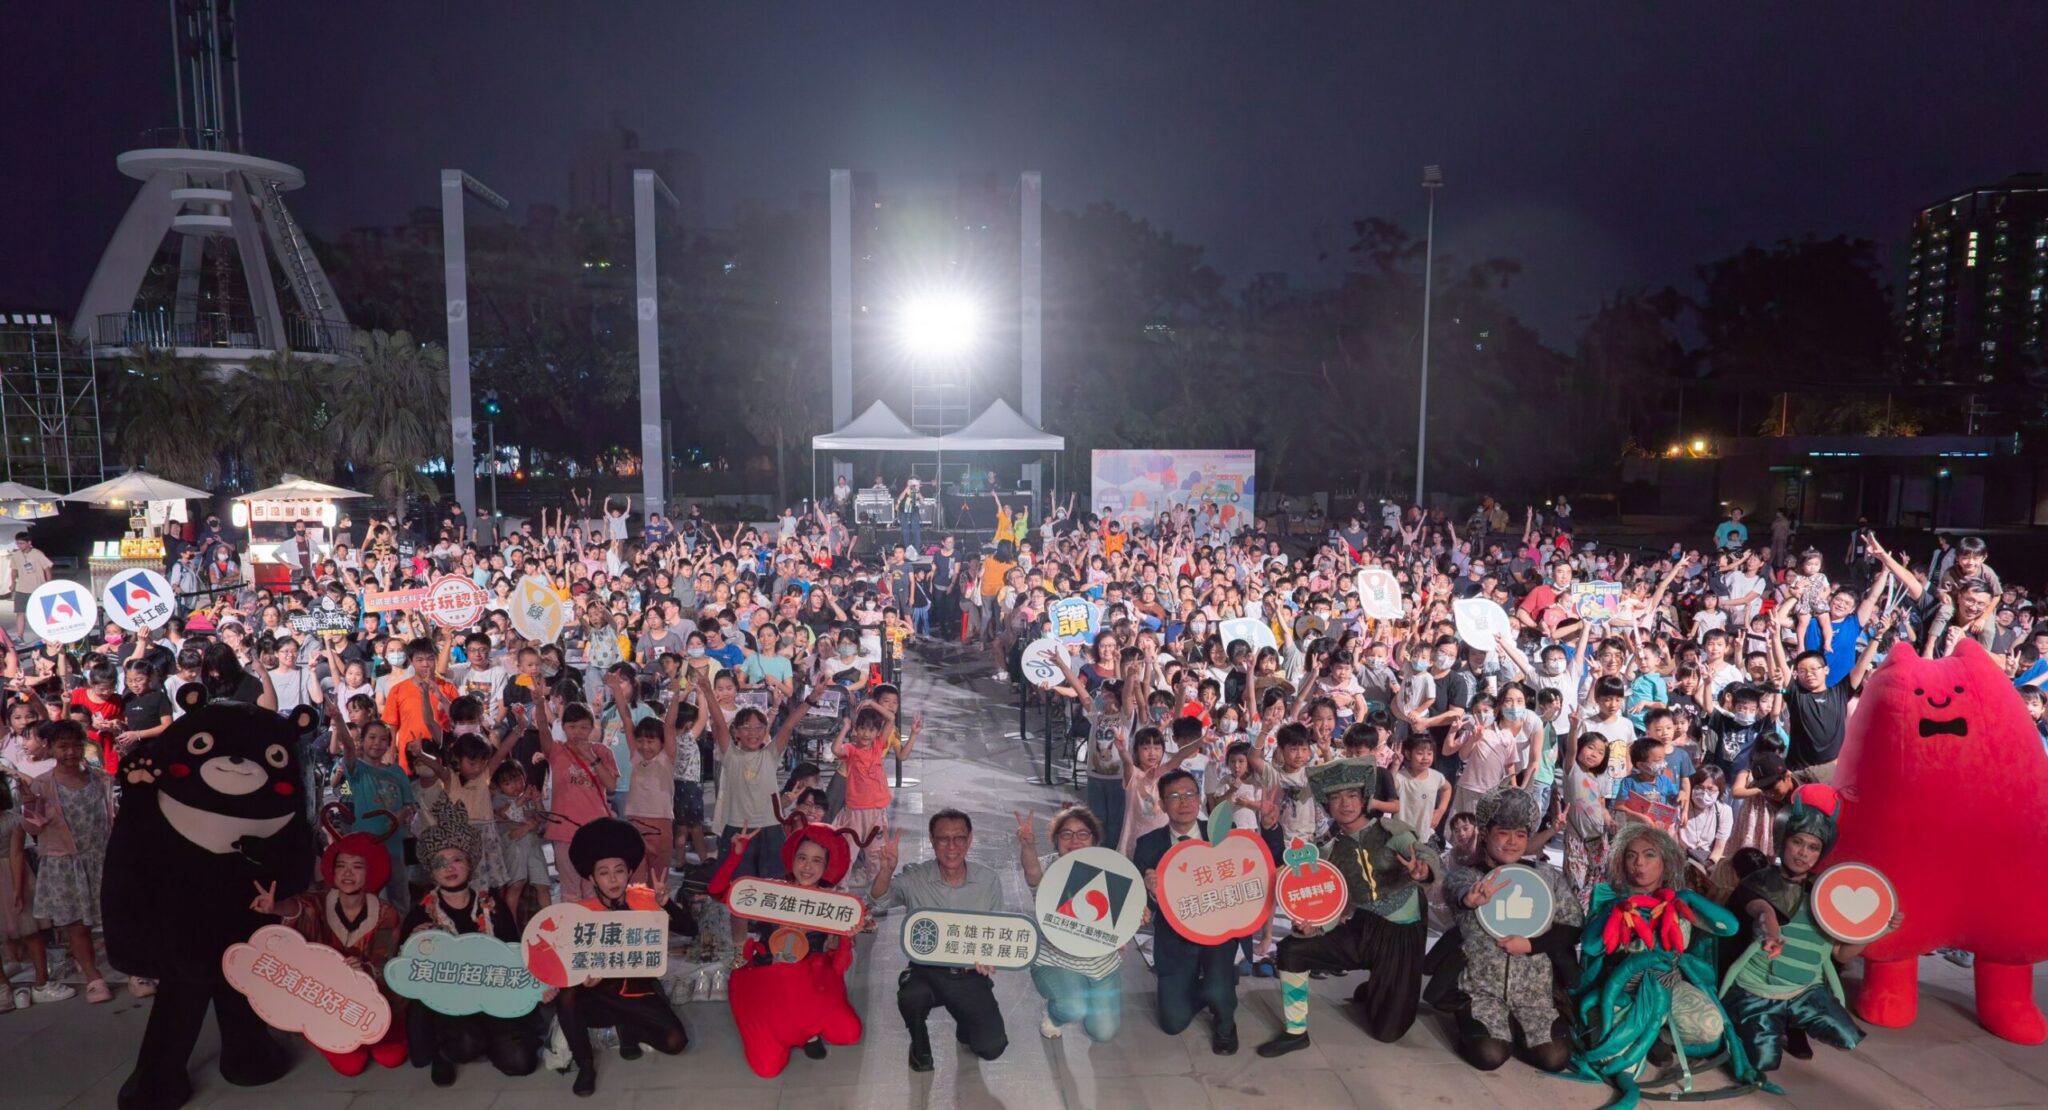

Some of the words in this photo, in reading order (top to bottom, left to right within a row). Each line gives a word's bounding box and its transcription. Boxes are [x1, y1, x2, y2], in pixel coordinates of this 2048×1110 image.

[420, 590, 490, 612] 好玩認證
[526, 603, 545, 621] 綠
[131, 602, 169, 627] 科工館
[1057, 604, 1090, 637] 讚
[1192, 858, 1238, 887] 我愛
[1178, 877, 1265, 920] 蘋果劇團
[1288, 881, 1336, 903] 玩轉科學
[760, 892, 854, 922] 高雄市政府
[574, 921, 663, 946] 好康都在
[946, 923, 1032, 944] 高雄市政府
[1043, 912, 1120, 944] 國立科學工藝博物館
[571, 950, 662, 970] 臺灣科學節
[944, 940, 1030, 960] 經濟發展局
[252, 953, 376, 1031] 表演超好看!
